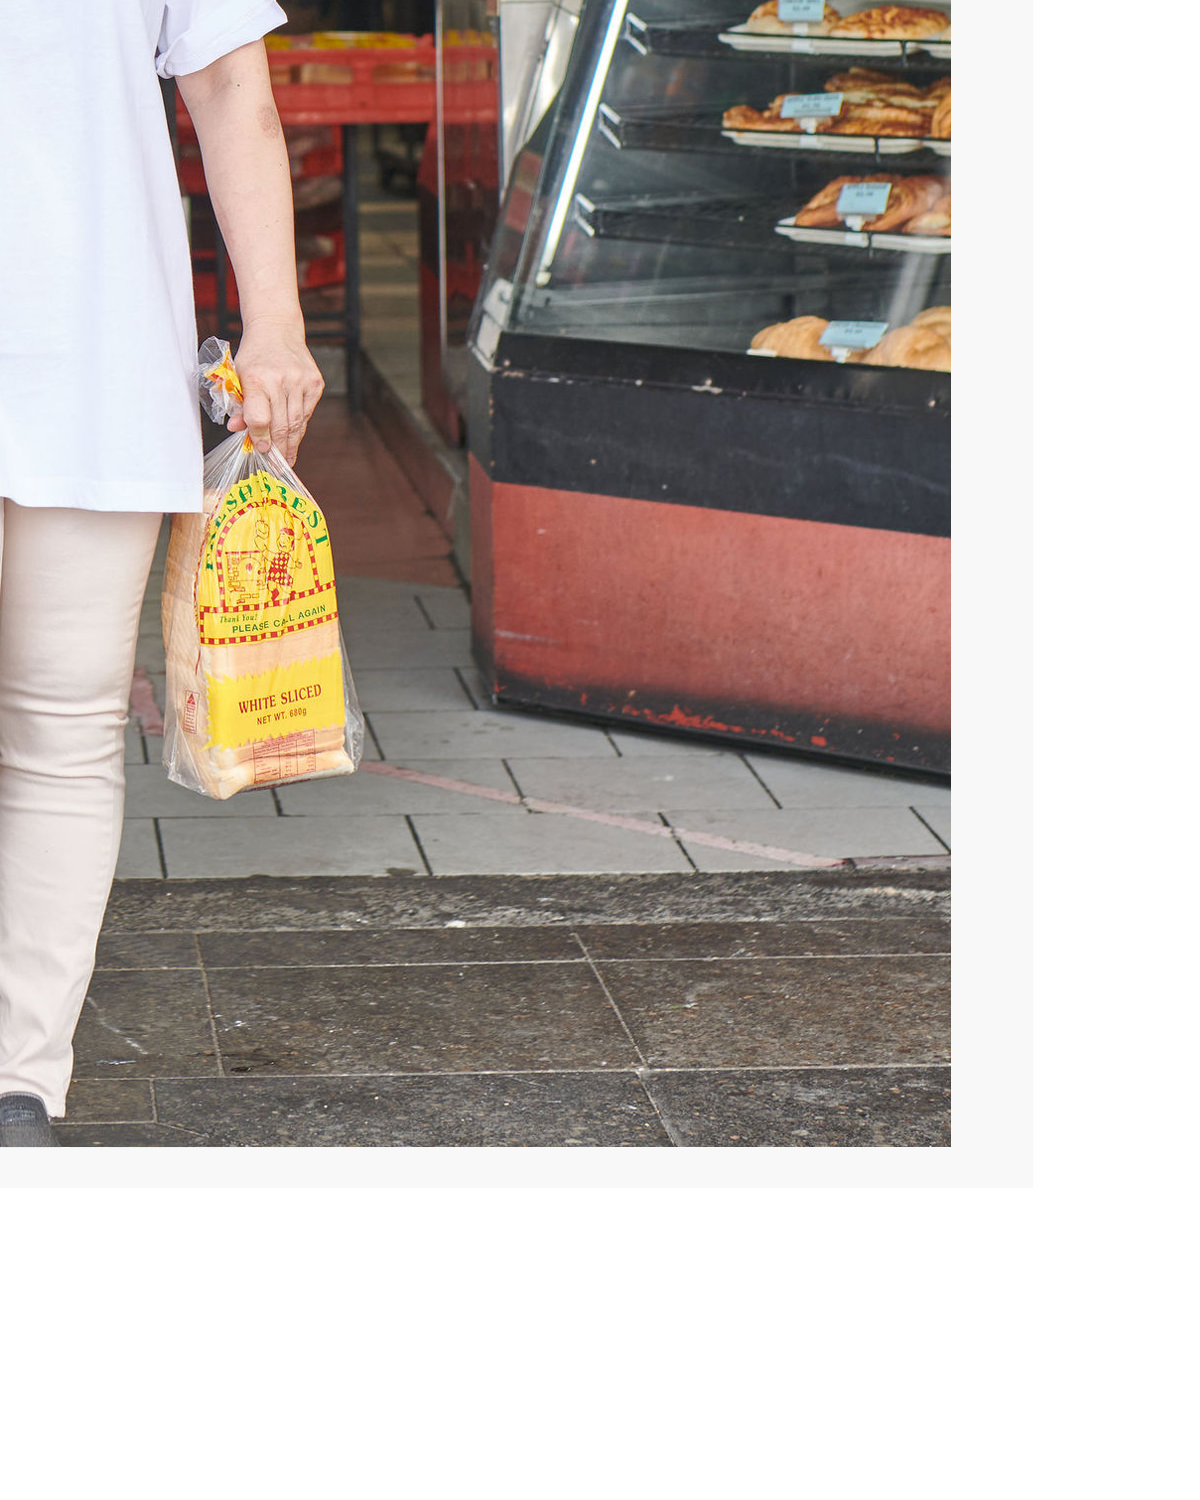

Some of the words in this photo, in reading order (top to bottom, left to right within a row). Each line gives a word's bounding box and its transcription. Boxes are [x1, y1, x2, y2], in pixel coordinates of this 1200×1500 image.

[220, 615, 240, 624] Thank
[232, 620, 270, 633] PLEASE
[273, 613, 296, 628] CAL
[298, 604, 327, 620] AGAIN
[238, 694, 277, 714] WHITE
[280, 683, 322, 705] SLICED
[256, 714, 272, 726] NET
[289, 707, 307, 719] 680g
